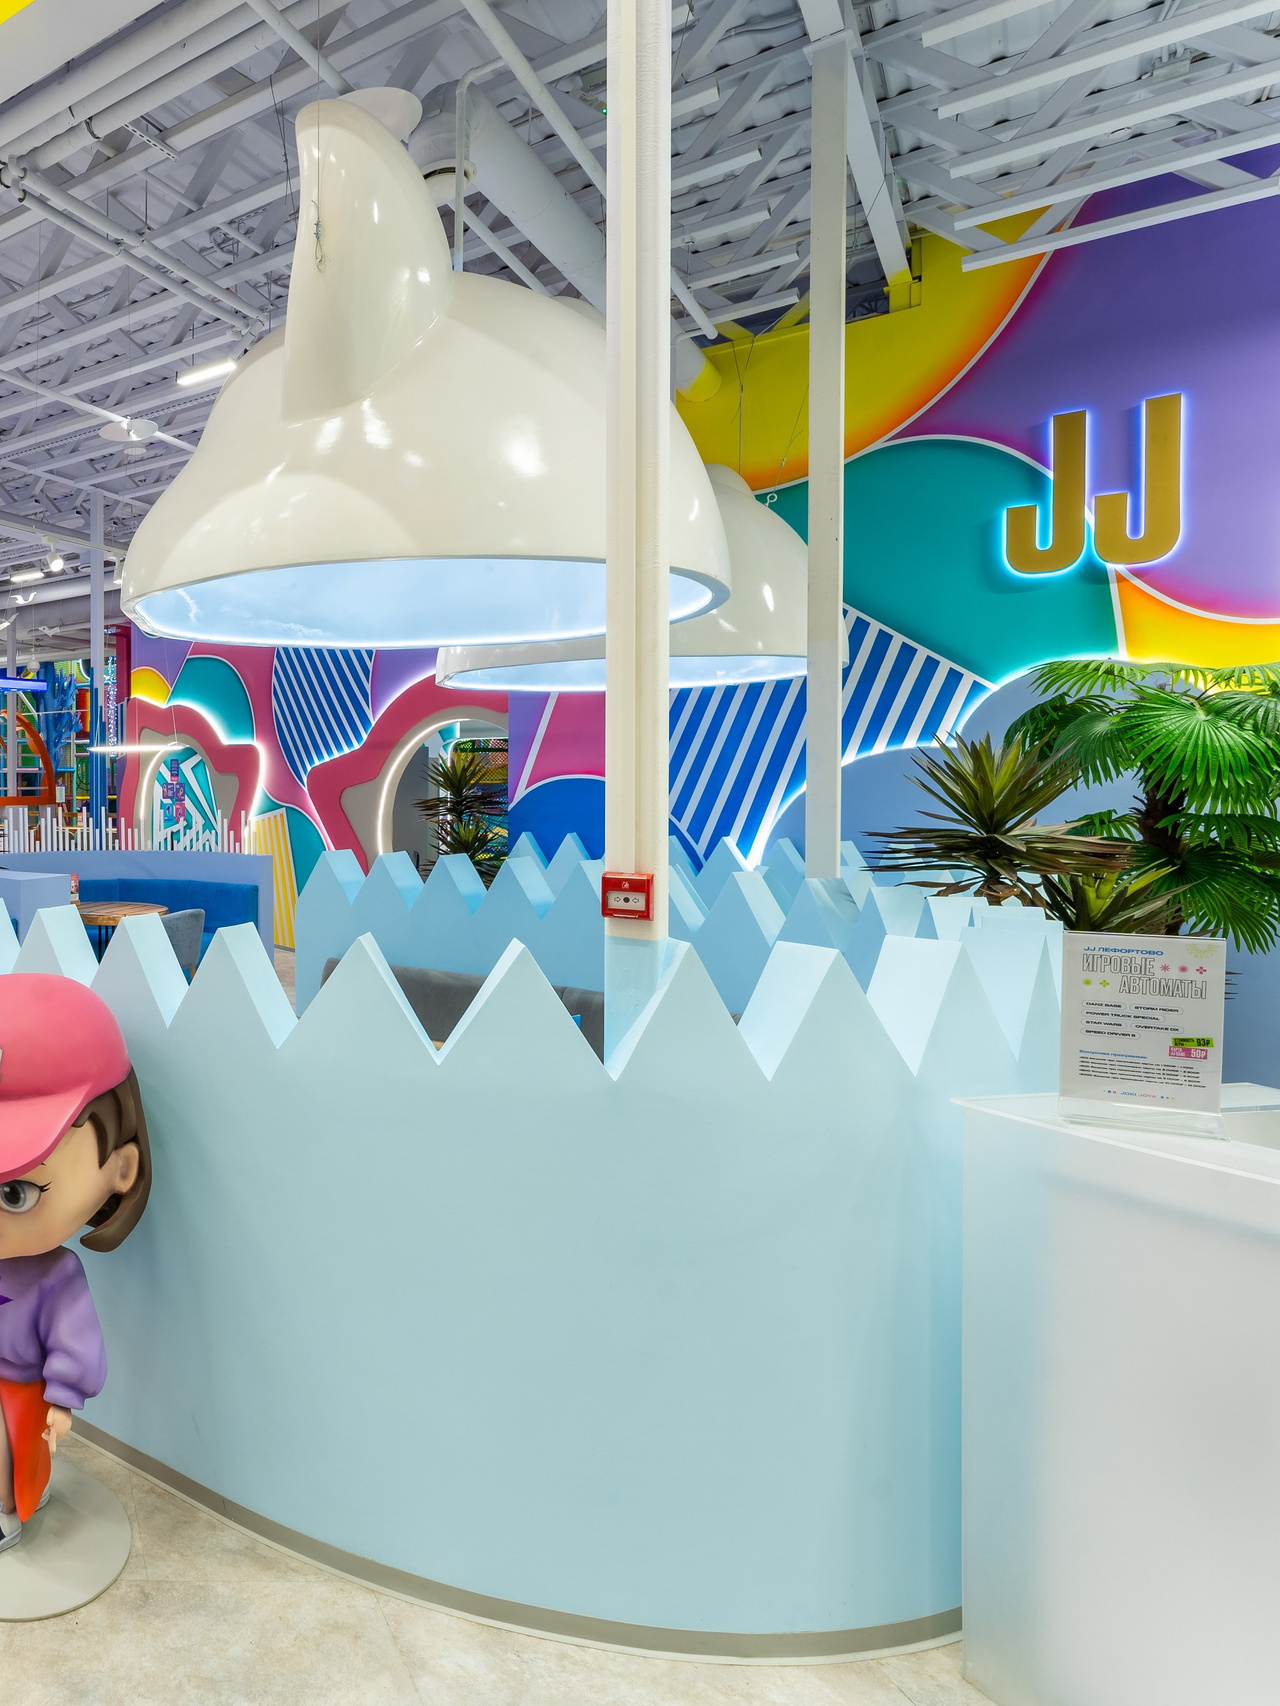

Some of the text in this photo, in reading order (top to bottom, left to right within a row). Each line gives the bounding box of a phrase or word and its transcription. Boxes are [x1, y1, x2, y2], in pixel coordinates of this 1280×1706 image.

[1006, 393, 1182, 574] JJ
[1098, 946, 1164, 956] ЛЕФОРТОВО
[1082, 953, 1155, 976] ИГРОВЫЕ
[1119, 975, 1207, 1000] АВТОМАТЫ
